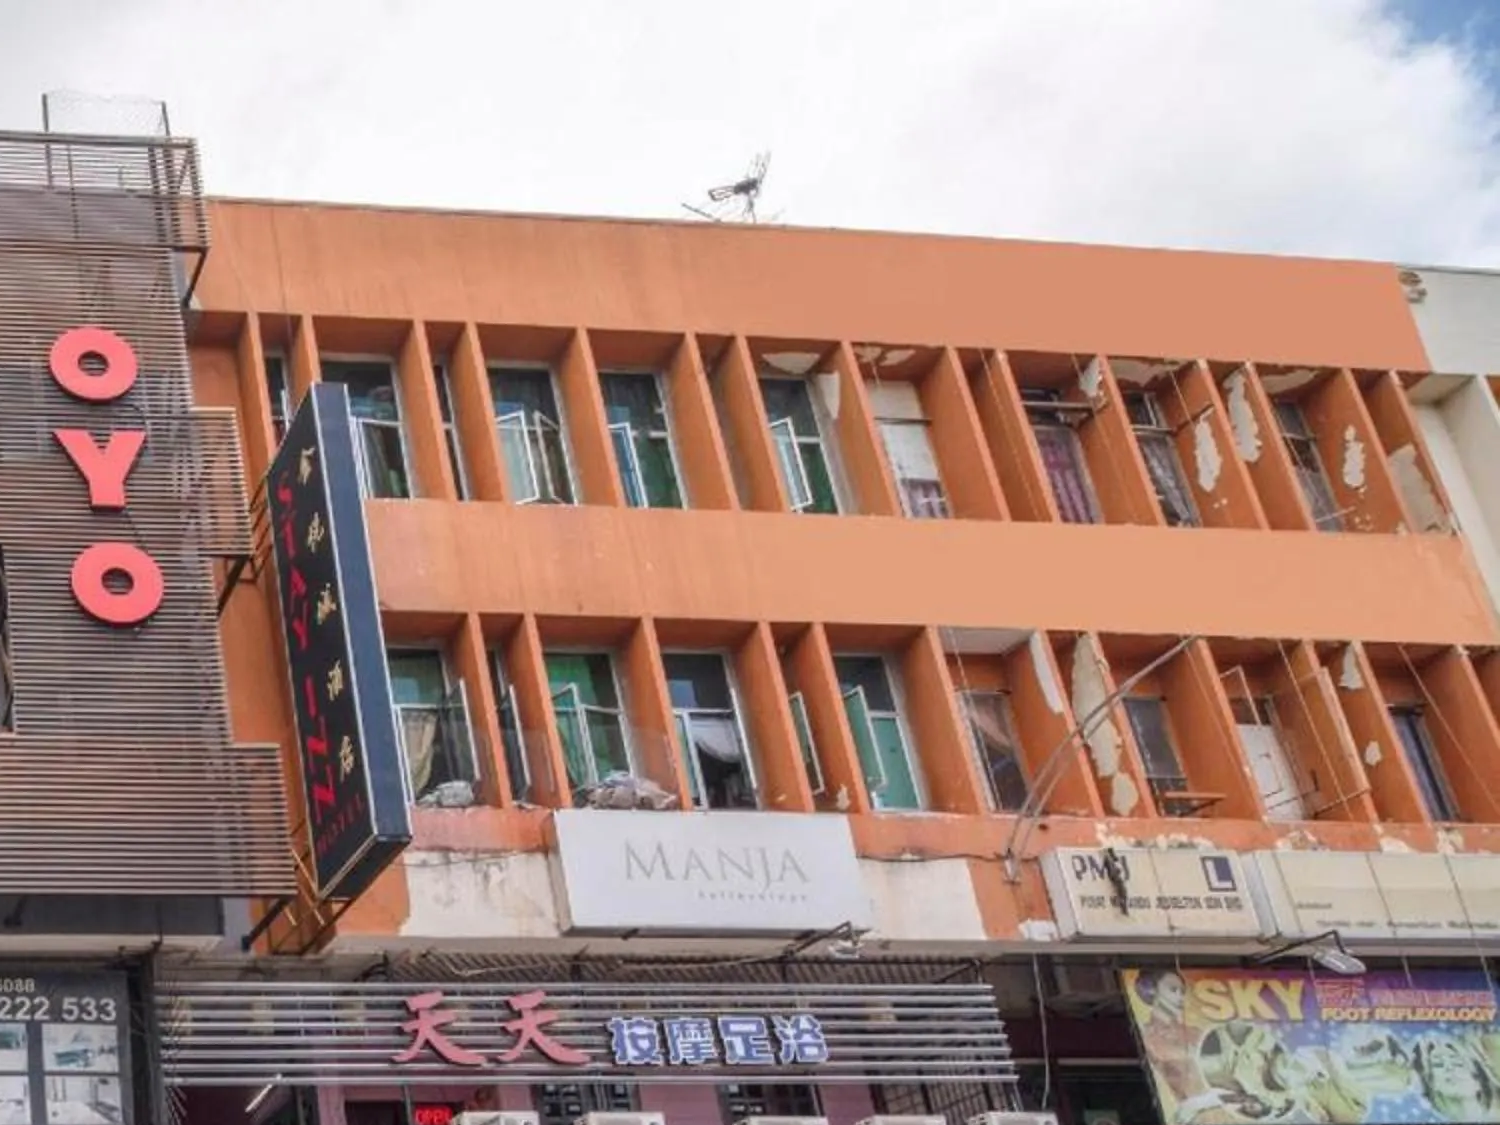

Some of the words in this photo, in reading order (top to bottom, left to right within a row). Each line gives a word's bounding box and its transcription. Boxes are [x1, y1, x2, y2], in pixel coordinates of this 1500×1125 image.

[48, 325, 164, 626] OYO
[625, 837, 810, 892] MANJA
[62, 997, 118, 1022] 533
[1192, 979, 1304, 1022] SKY
[1321, 1007, 1371, 1021] FOOT
[1375, 1006, 1496, 1022] REFLEXOLOGY
